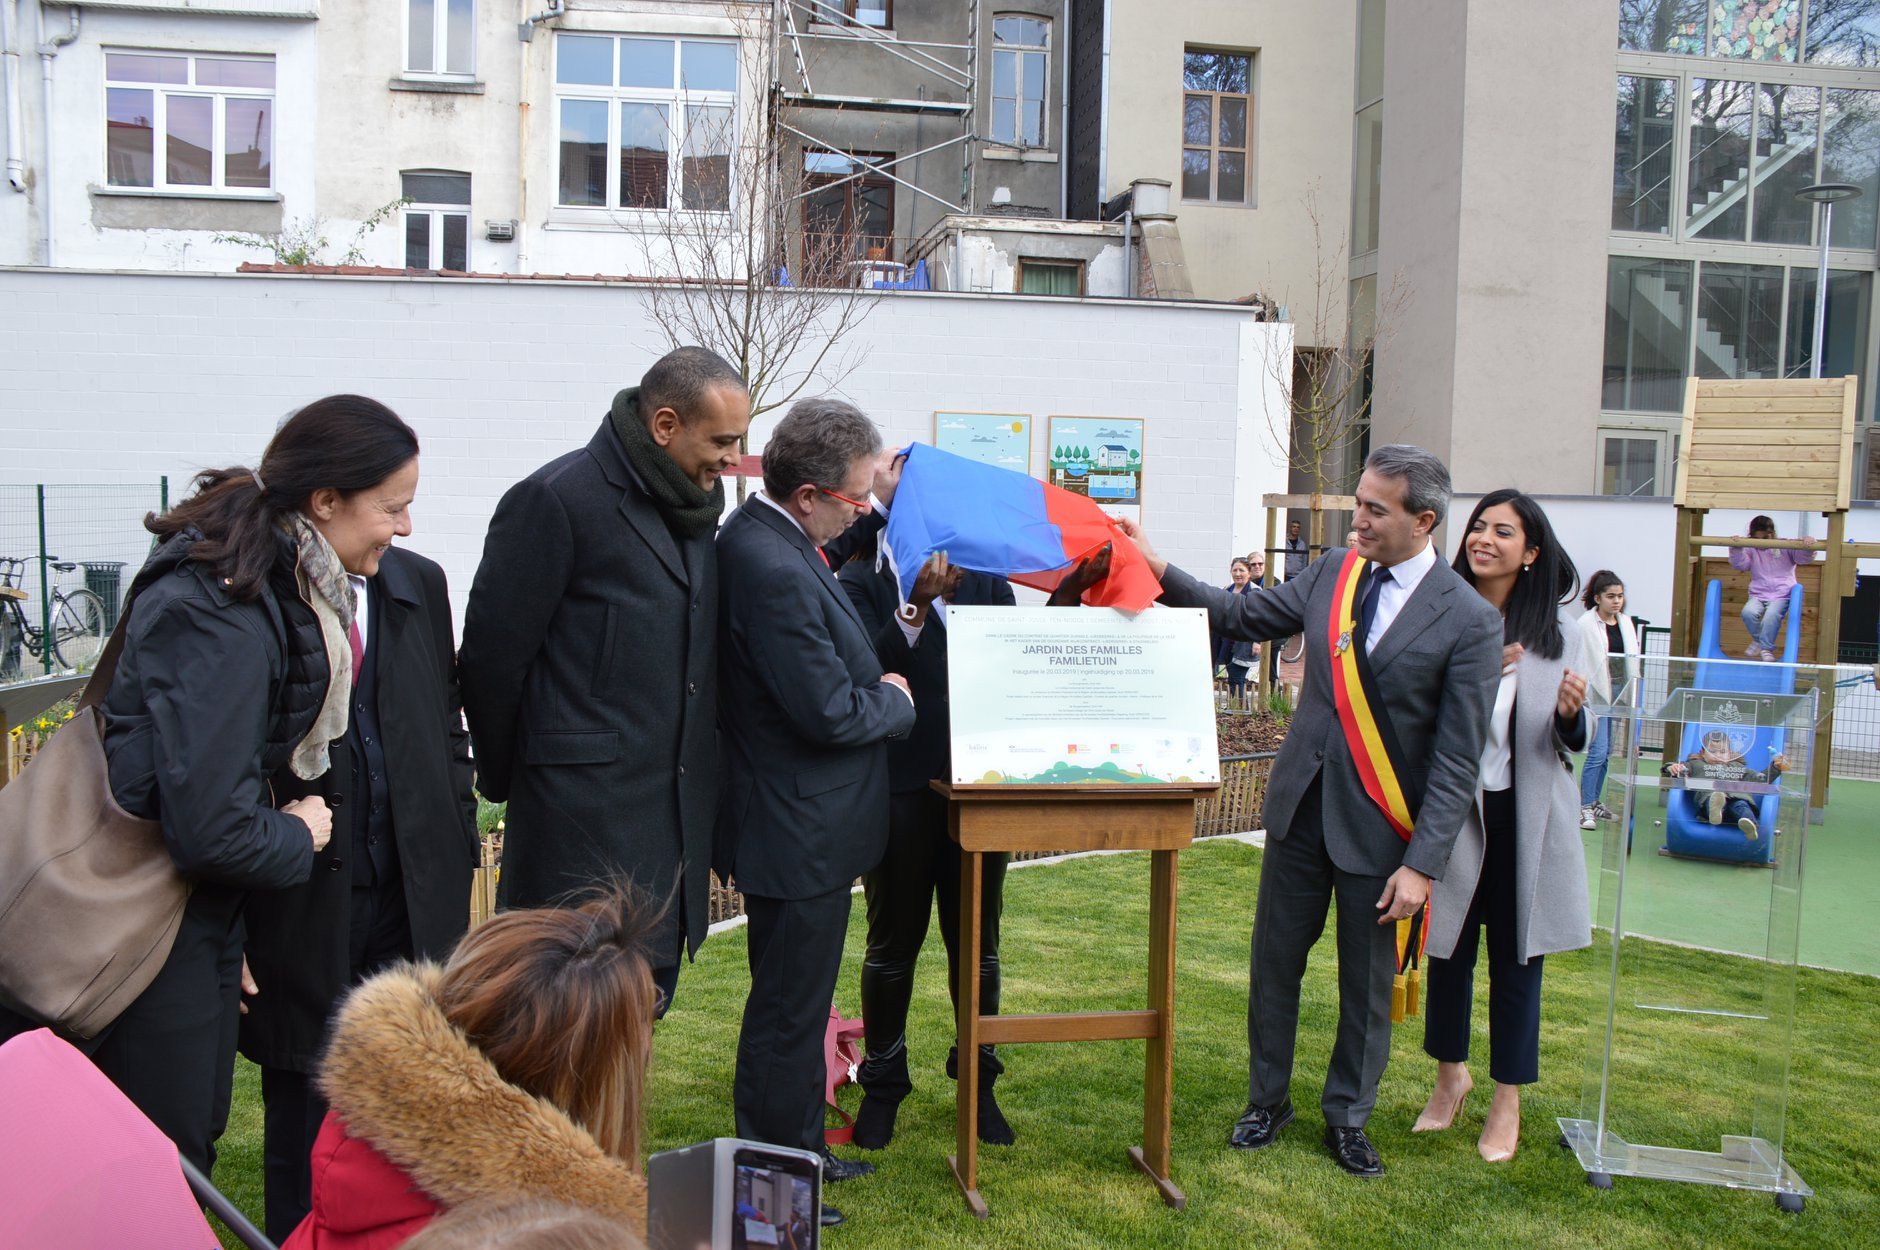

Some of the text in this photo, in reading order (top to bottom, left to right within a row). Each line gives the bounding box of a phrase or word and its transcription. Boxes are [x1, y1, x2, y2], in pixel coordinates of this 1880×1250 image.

[1022, 645, 1143, 655] JARDIN DES FAMILLES
[1049, 656, 1117, 666] FAMILIETUIN
